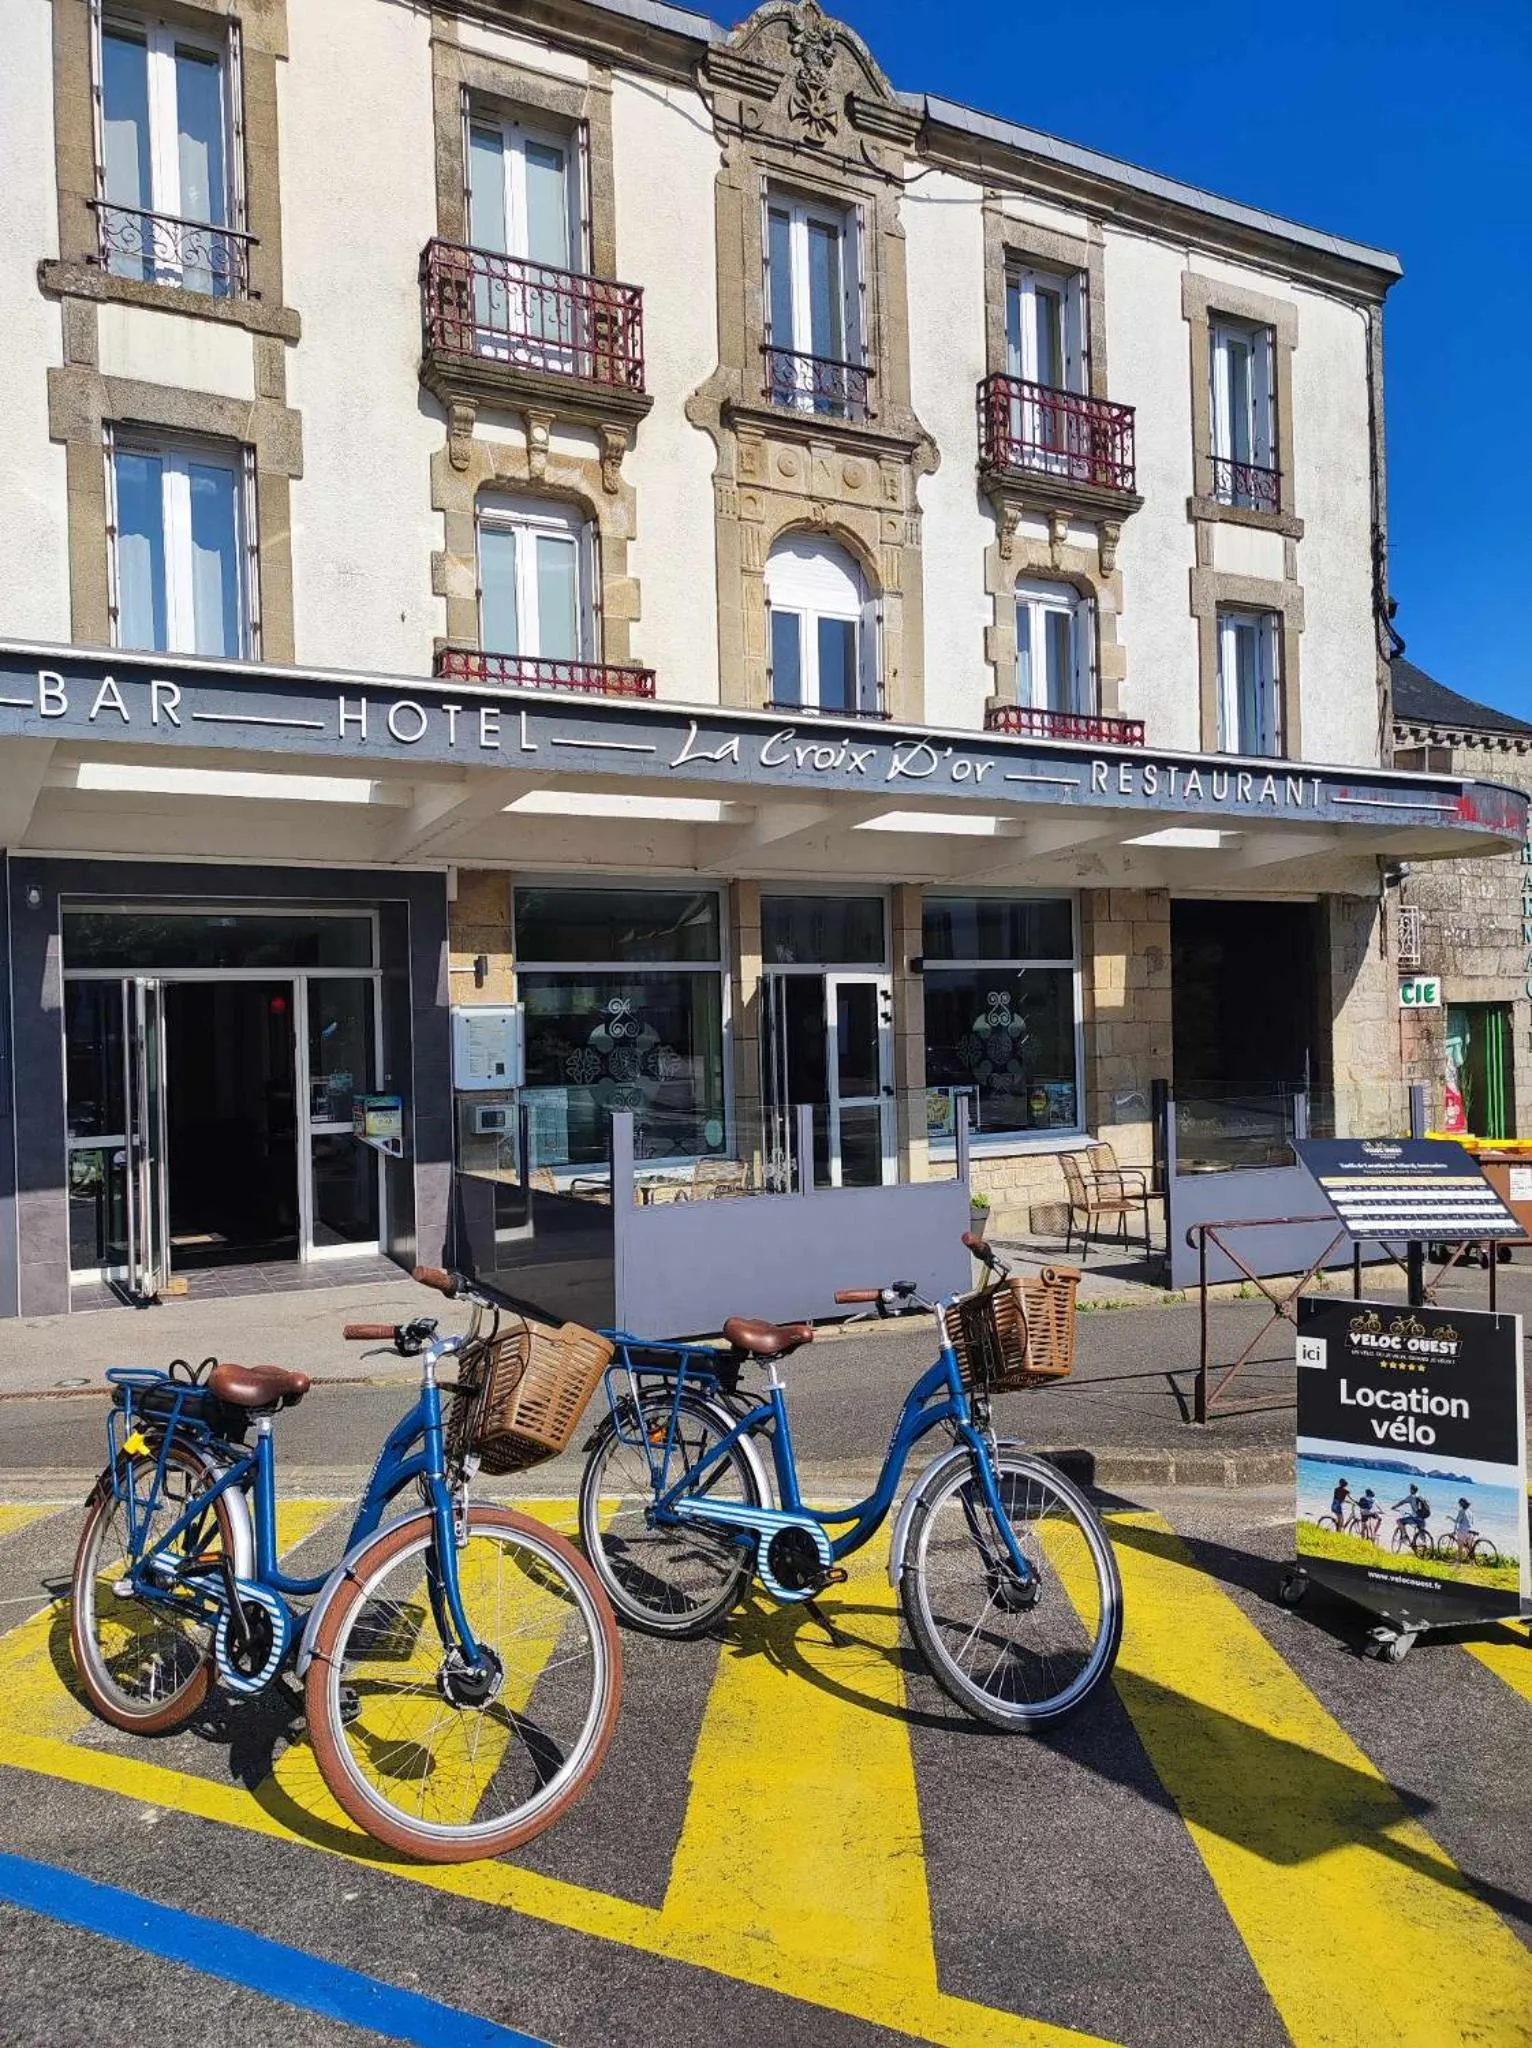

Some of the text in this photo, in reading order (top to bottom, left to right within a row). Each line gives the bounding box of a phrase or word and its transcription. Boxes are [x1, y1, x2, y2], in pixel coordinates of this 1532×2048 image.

[38, 671, 1323, 806] BAR HOTEL La Croix D'or RESTAURANT
[1401, 983, 1436, 1005] CIE
[1301, 1343, 1322, 1362] ici
[1339, 1378, 1470, 1420] Location
[1370, 1415, 1436, 1446] vélo
